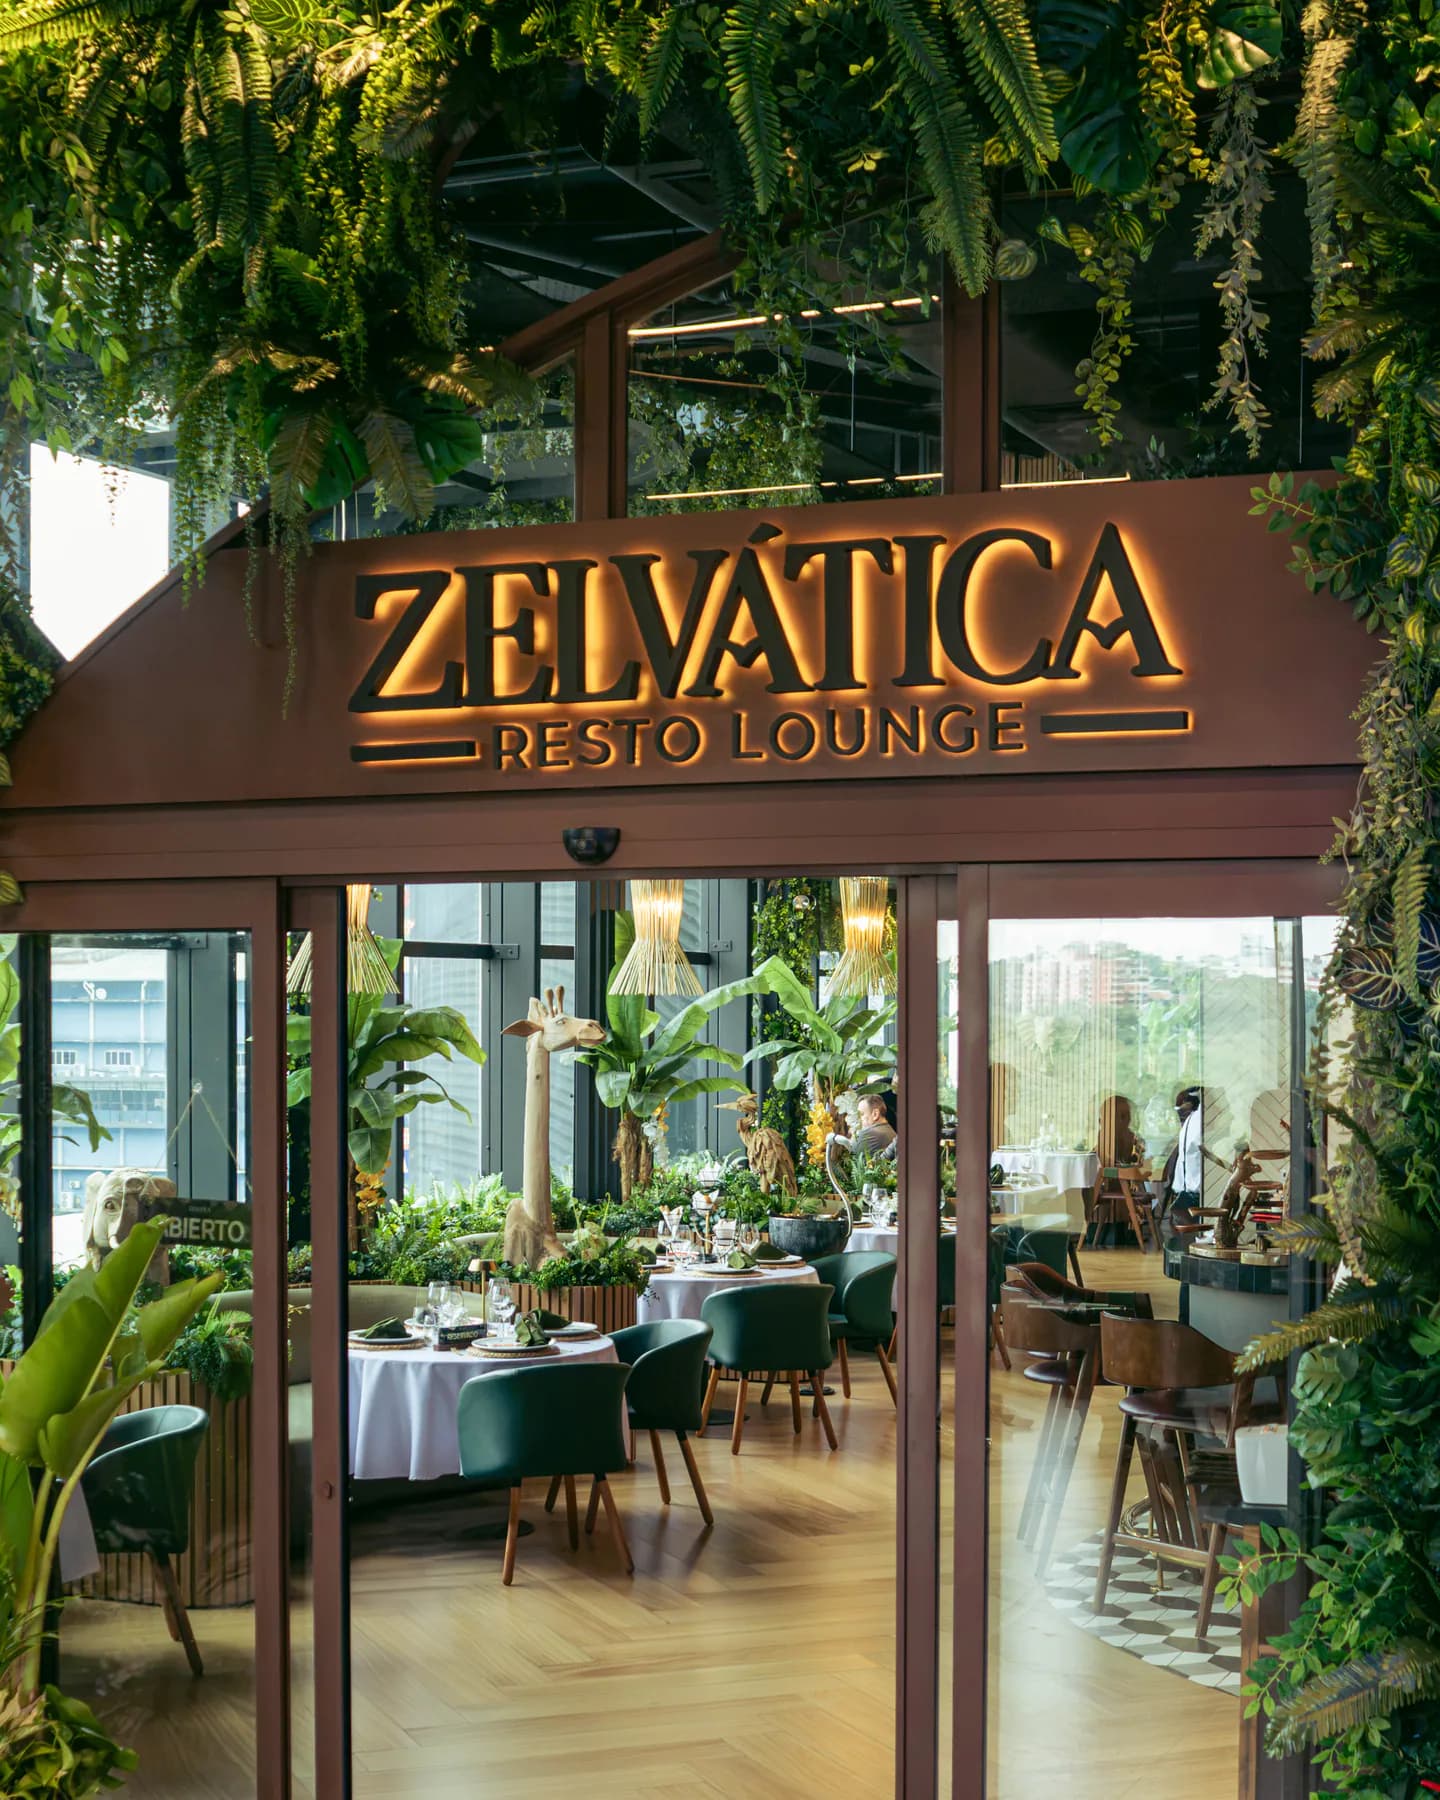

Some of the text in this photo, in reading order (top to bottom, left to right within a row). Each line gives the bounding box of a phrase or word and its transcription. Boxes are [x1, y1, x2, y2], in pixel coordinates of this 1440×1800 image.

[349, 521, 1183, 712] ZELVÁTICA
[493, 701, 1025, 770] RESTO LOUNGE
